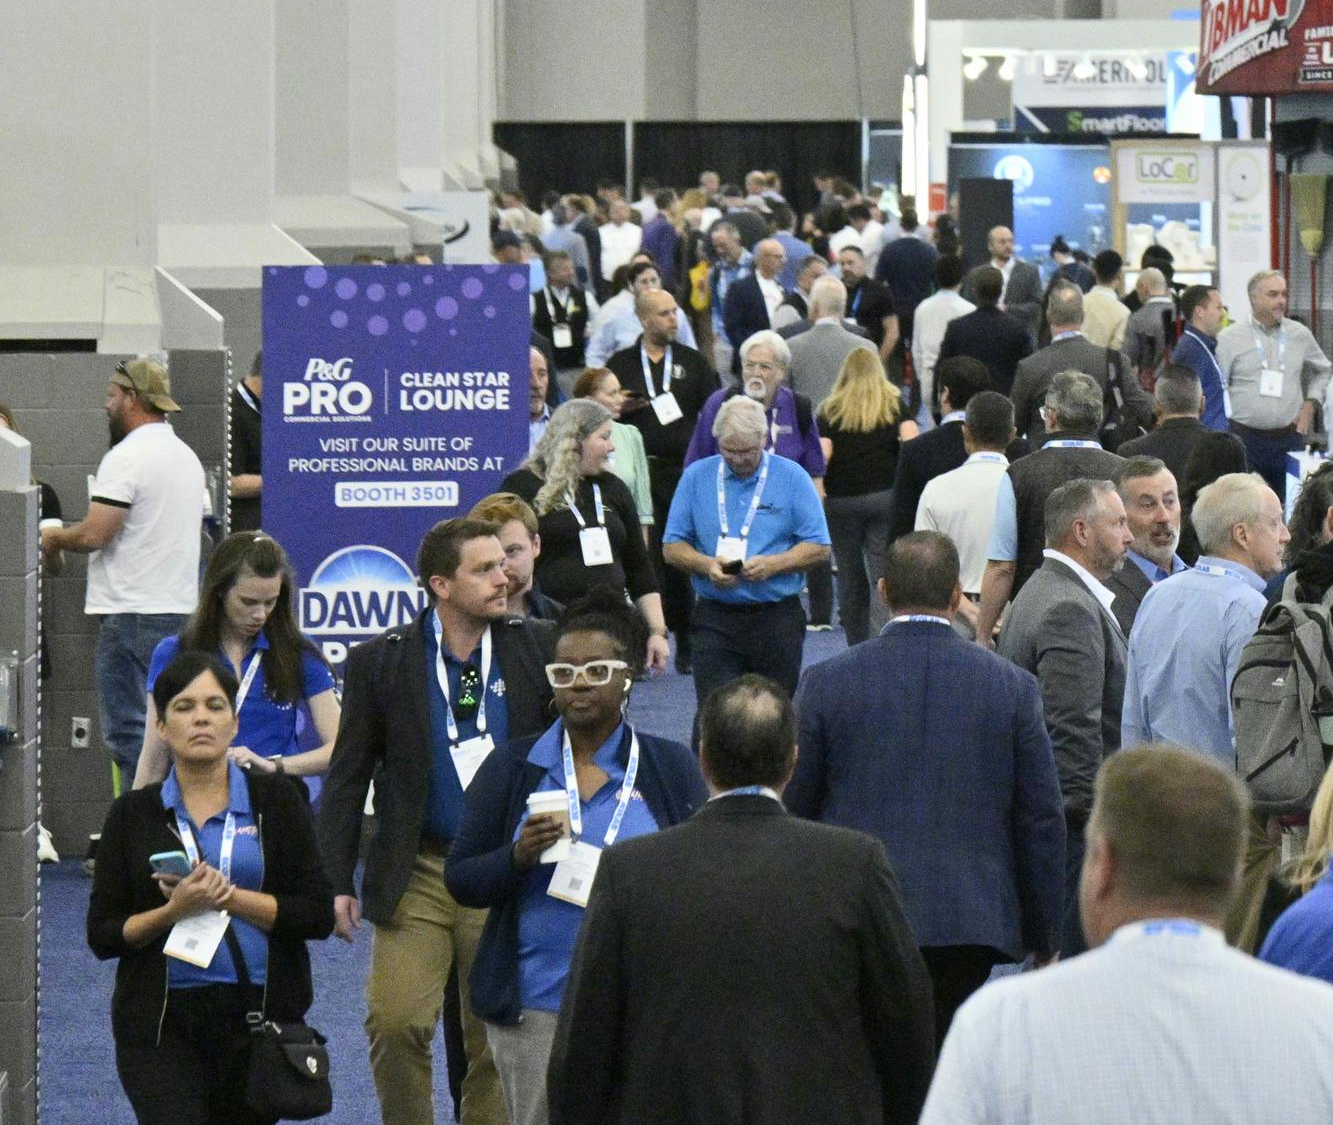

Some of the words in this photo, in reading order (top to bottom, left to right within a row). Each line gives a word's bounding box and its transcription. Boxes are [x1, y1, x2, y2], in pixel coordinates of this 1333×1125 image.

[304, 357, 353, 382] P&G
[400, 372, 460, 388] CLEAN
[462, 371, 510, 387] STAR
[283, 381, 373, 416] PRO
[400, 389, 511, 412] LOUNGE
[319, 437, 360, 453] VISIT
[362, 437, 399, 453] OUR
[402, 437, 446, 452] SUITE
[450, 436, 474, 451] OF
[288, 458, 409, 473] PROFESSIONAL
[412, 457, 479, 472] BRANDS
[482, 456, 505, 471] AT
[341, 487, 407, 502] BOOTH
[411, 486, 453, 501] 3501
[303, 590, 425, 628] DAWN
